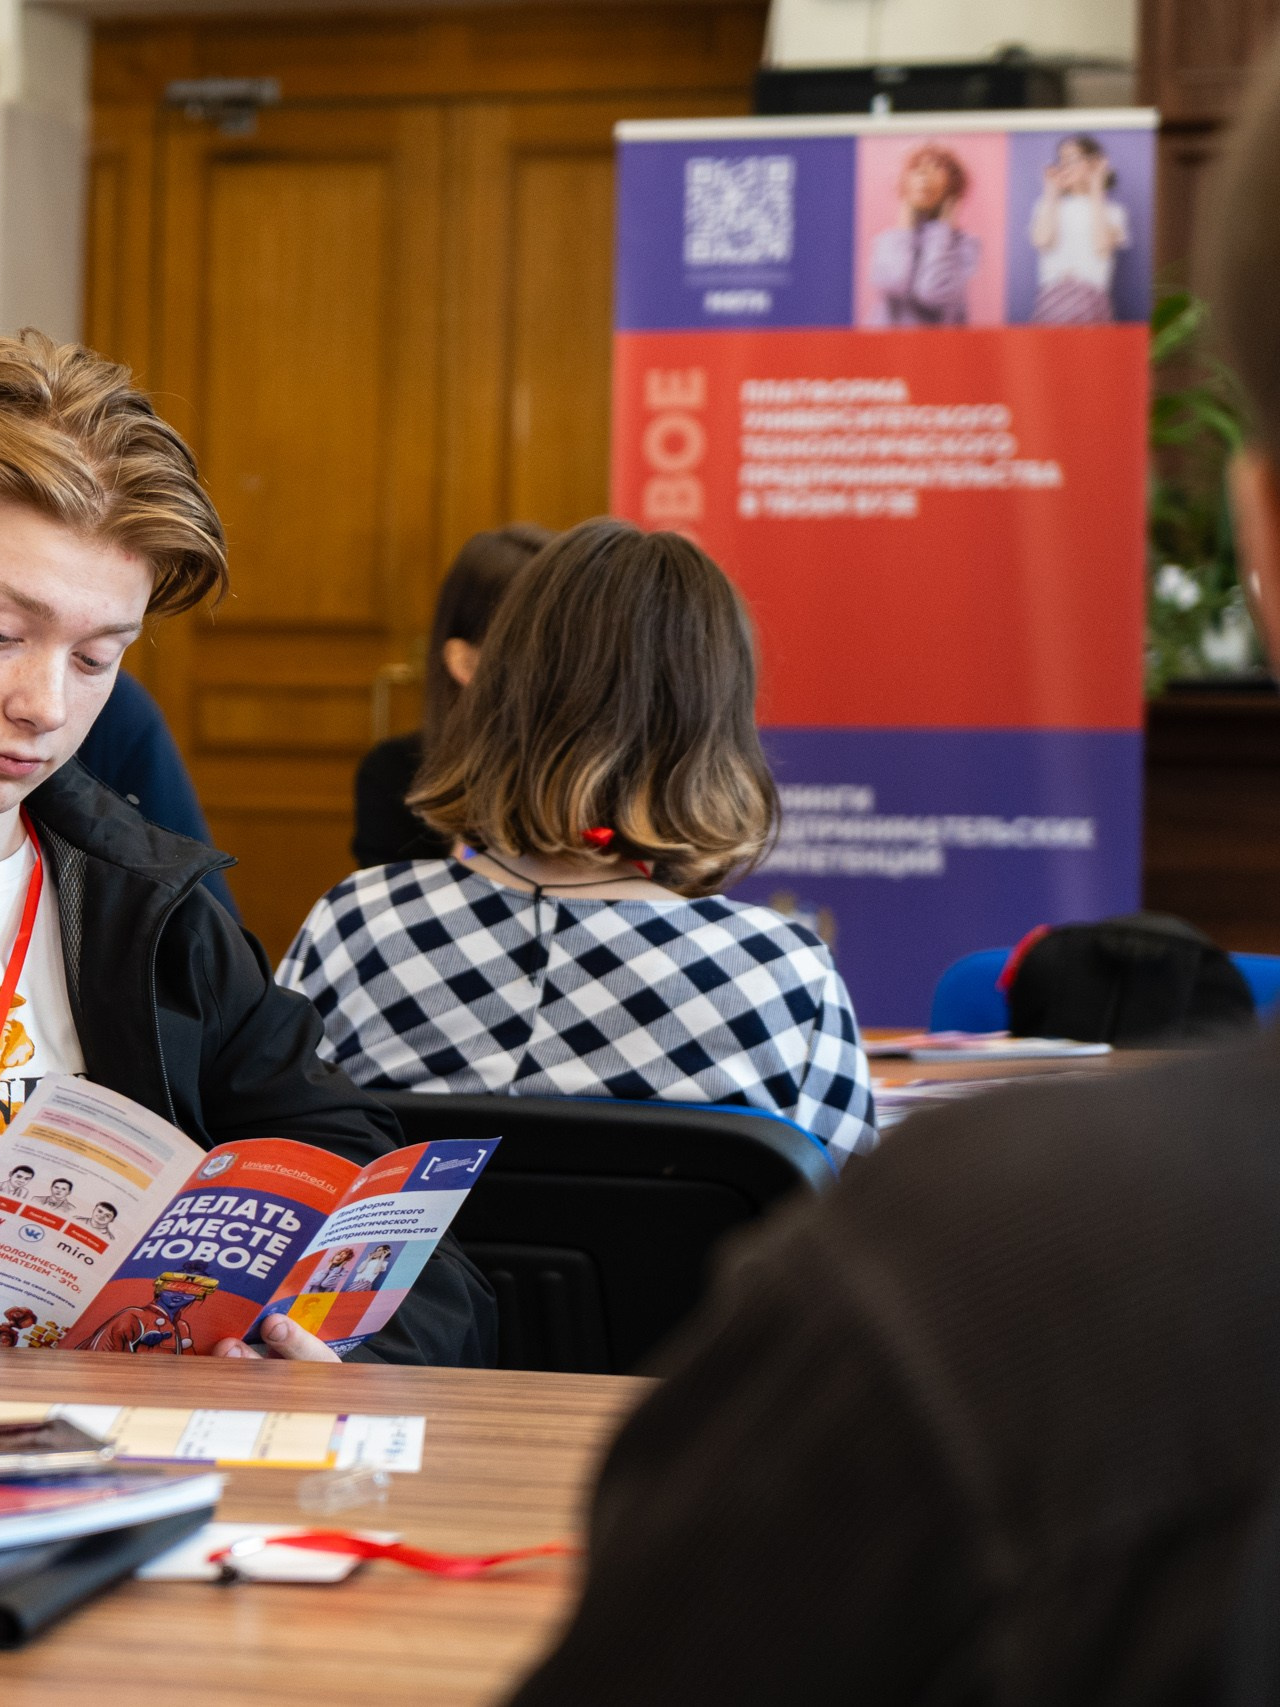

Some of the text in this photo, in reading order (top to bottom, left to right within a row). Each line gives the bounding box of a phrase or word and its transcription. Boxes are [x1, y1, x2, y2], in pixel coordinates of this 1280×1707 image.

[163, 1195, 301, 1232] ДЕЛАТЬ
[329, 1208, 425, 1230] университетского
[336, 1200, 395, 1220] Платформа
[148, 1217, 292, 1257] ВМЕСТЕ
[317, 1226, 439, 1248] предпринимательства
[324, 1217, 419, 1238] технологического
[56, 1241, 95, 1266] miro
[132, 1238, 277, 1280] НОВОЕ
